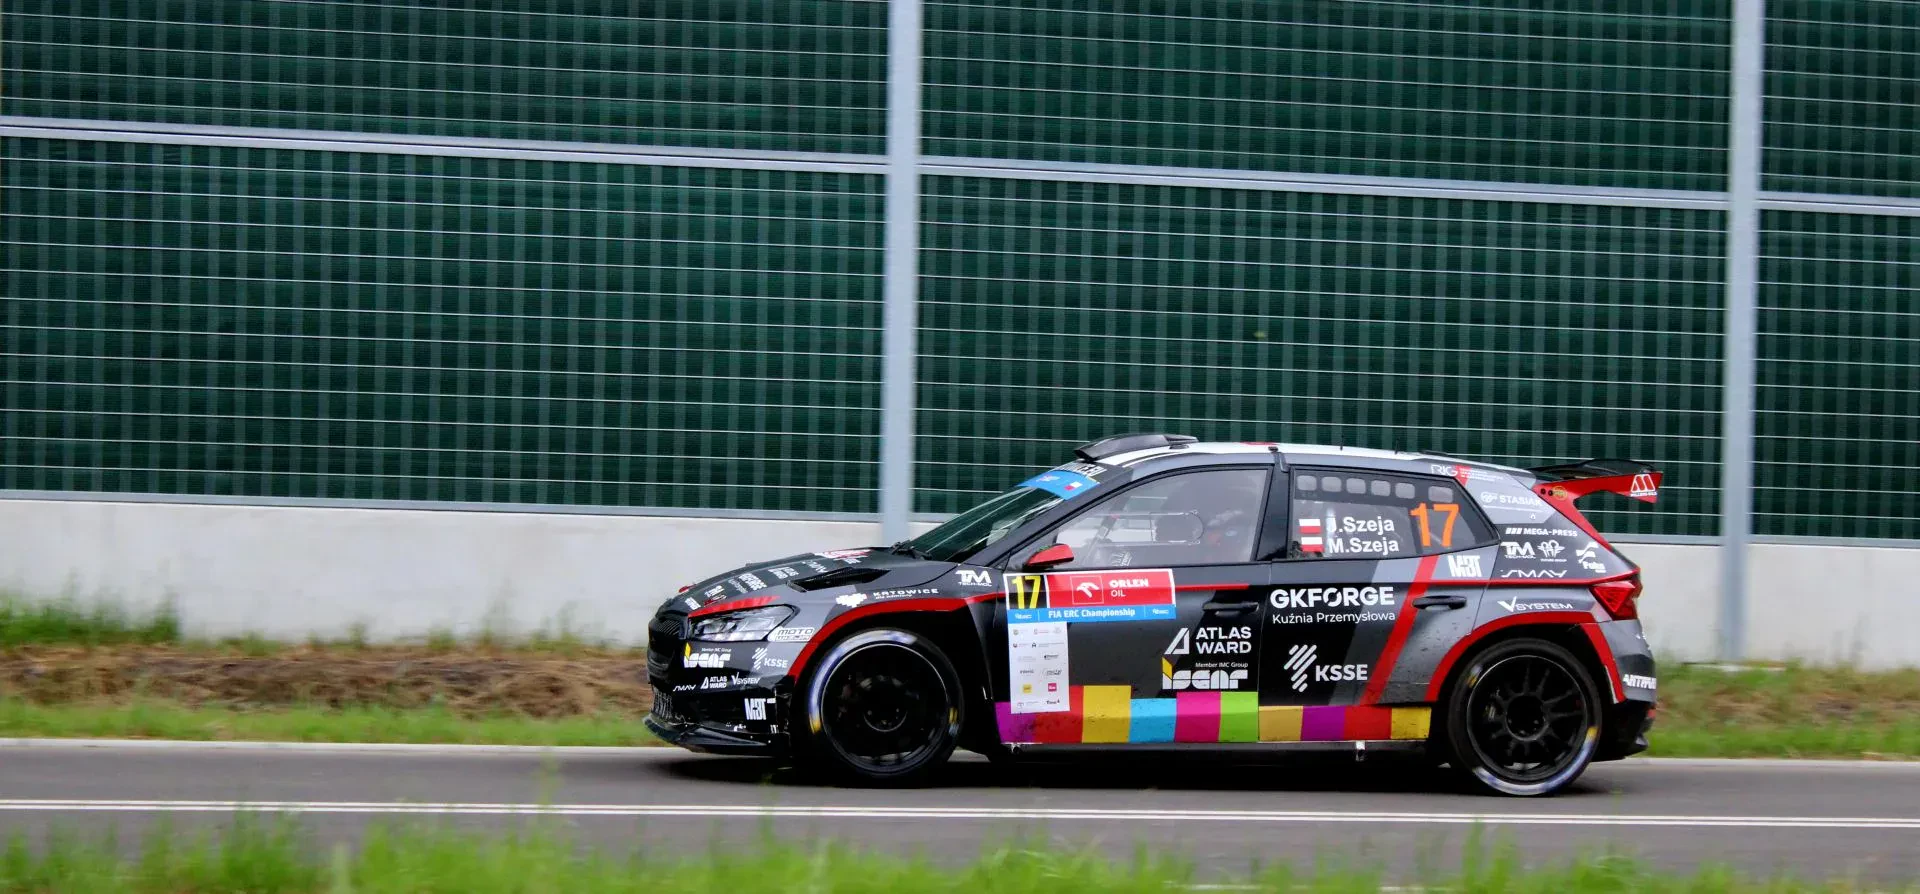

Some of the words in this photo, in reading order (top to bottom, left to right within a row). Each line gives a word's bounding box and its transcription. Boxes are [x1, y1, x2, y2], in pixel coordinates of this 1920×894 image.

[1326, 515, 1395, 535] J.Szeja
[1409, 502, 1460, 547] 17
[1523, 528, 1578, 537] MEGA-PRESS
[1328, 537, 1400, 555] M.Szeja
[1109, 578, 1149, 588] ORLEN
[873, 588, 939, 597] KATOWICE
[1012, 575, 1041, 609] 17
[1110, 590, 1126, 598] OIL
[1270, 586, 1395, 608] GKFORGE
[1048, 610, 1062, 619] FIA
[1064, 609, 1079, 618] ERC
[1081, 607, 1136, 618] Championship
[1272, 612, 1313, 624] Kuźnia
[1316, 611, 1396, 625] Przemysłowa
[1195, 626, 1252, 640] ATLAS
[1195, 641, 1252, 655] WARD
[763, 658, 789, 668] KSSE
[1315, 663, 1369, 681] KSSE
